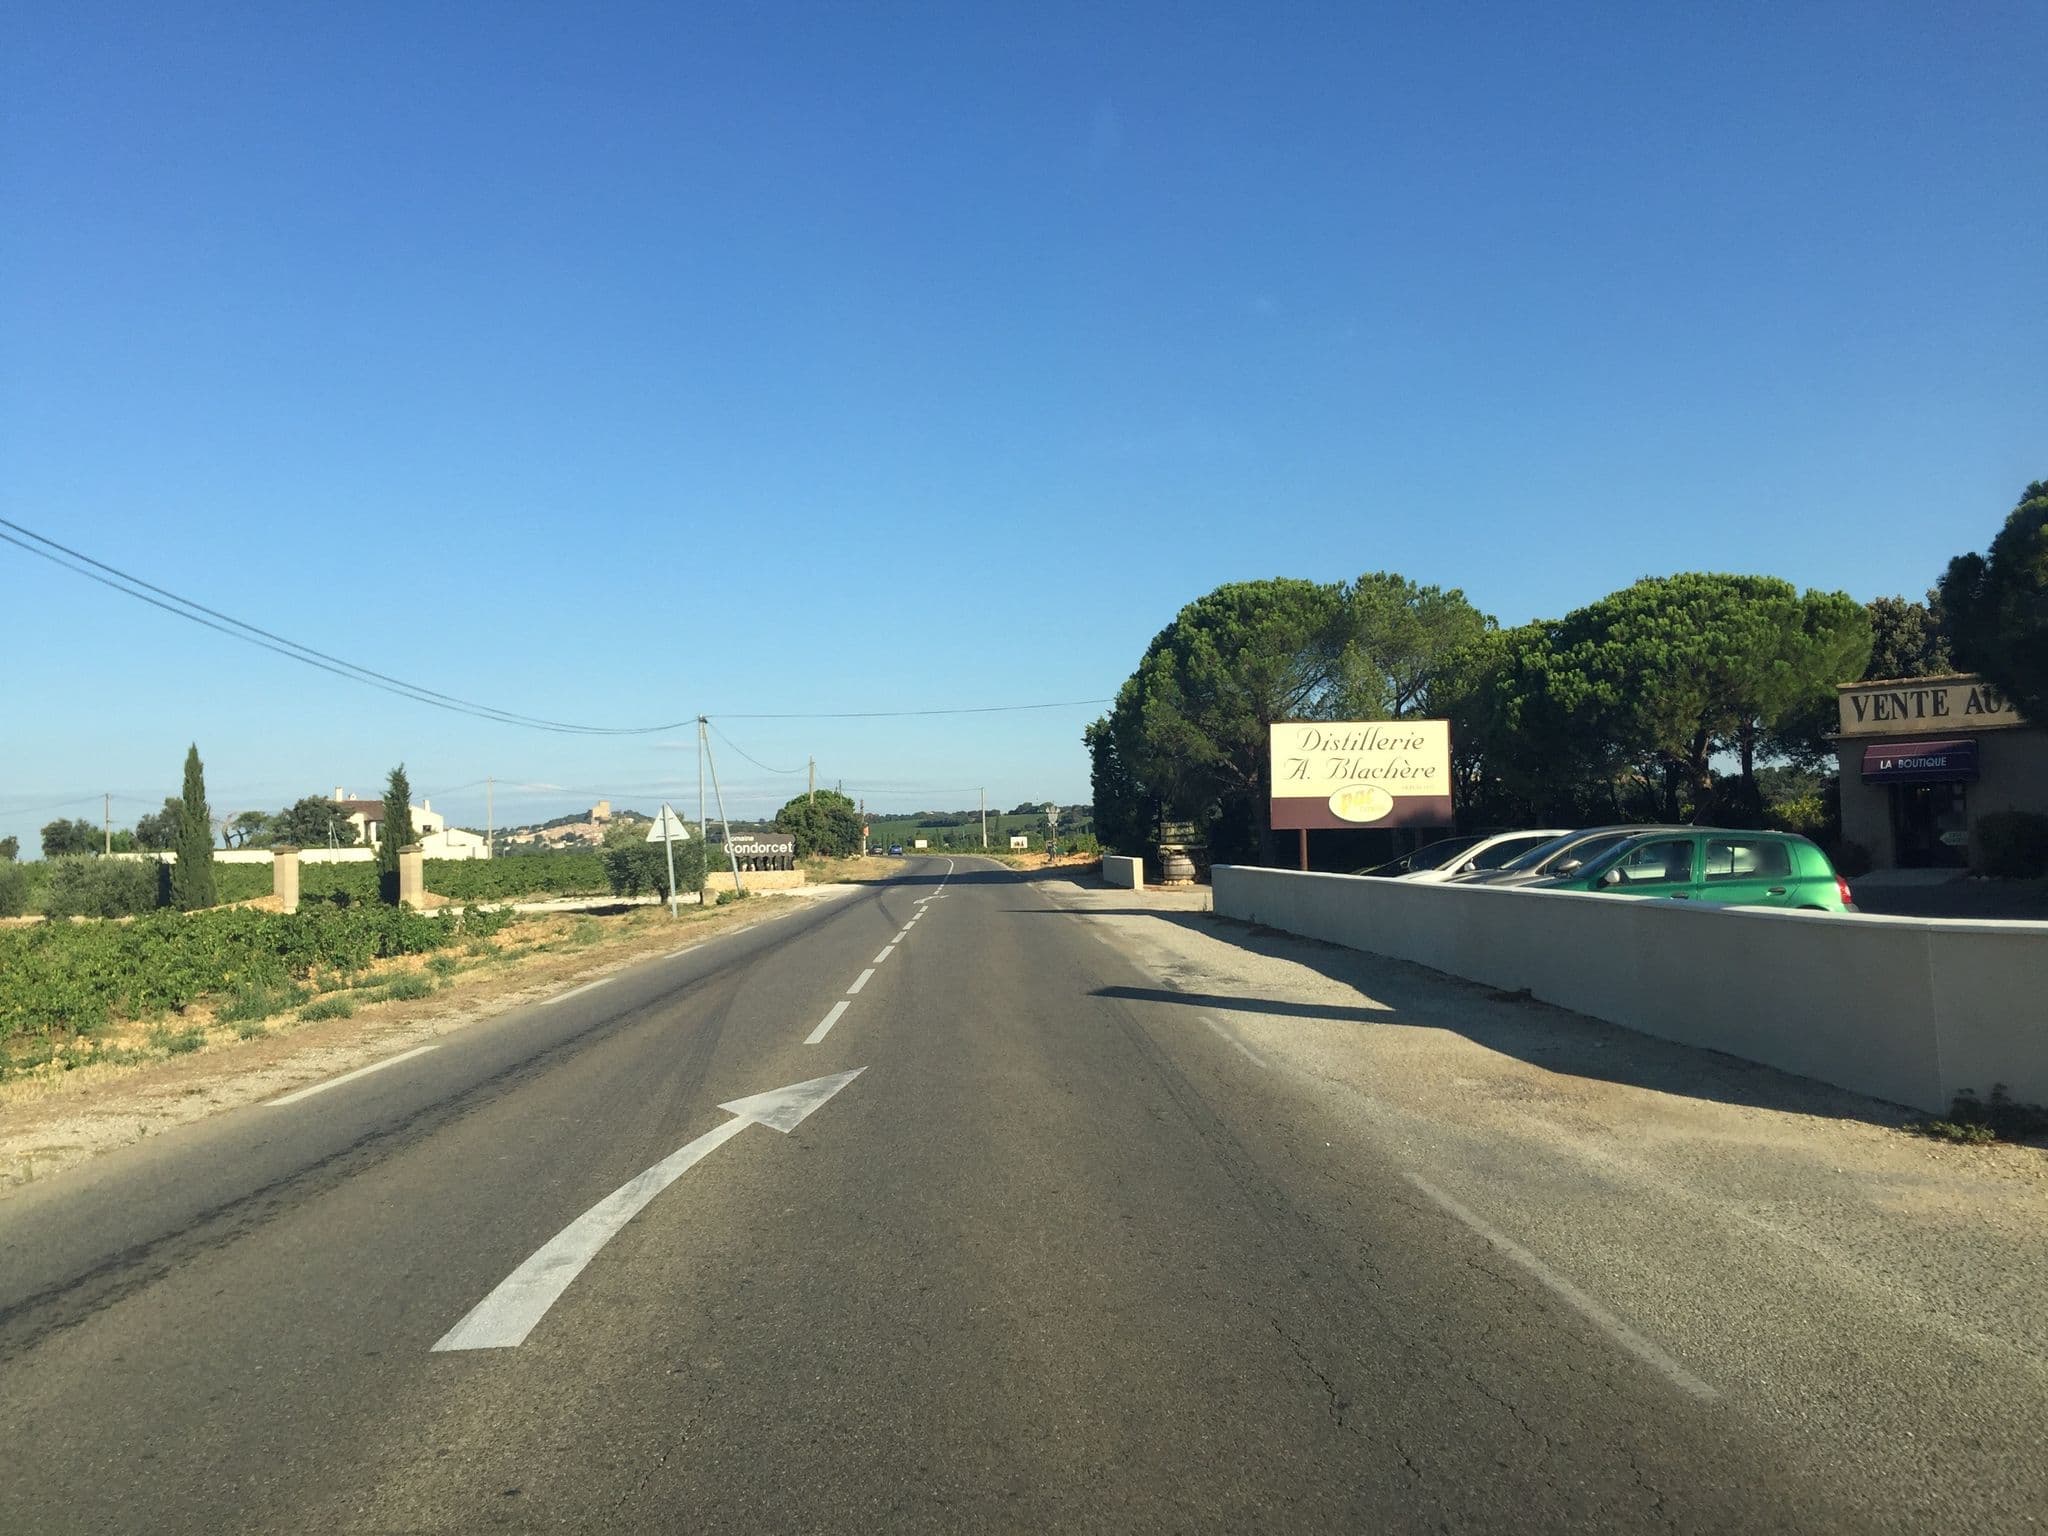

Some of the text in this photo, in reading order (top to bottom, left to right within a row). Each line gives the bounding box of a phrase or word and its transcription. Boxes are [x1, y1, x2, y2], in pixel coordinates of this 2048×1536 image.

[1851, 686, 2016, 723] VENTE AU
[1296, 726, 1425, 752] Distillerie
[1284, 756, 1436, 780] A. Blachère
[1880, 756, 1947, 770] LA BOUTIQUE
[724, 841, 793, 854] Condorcet
